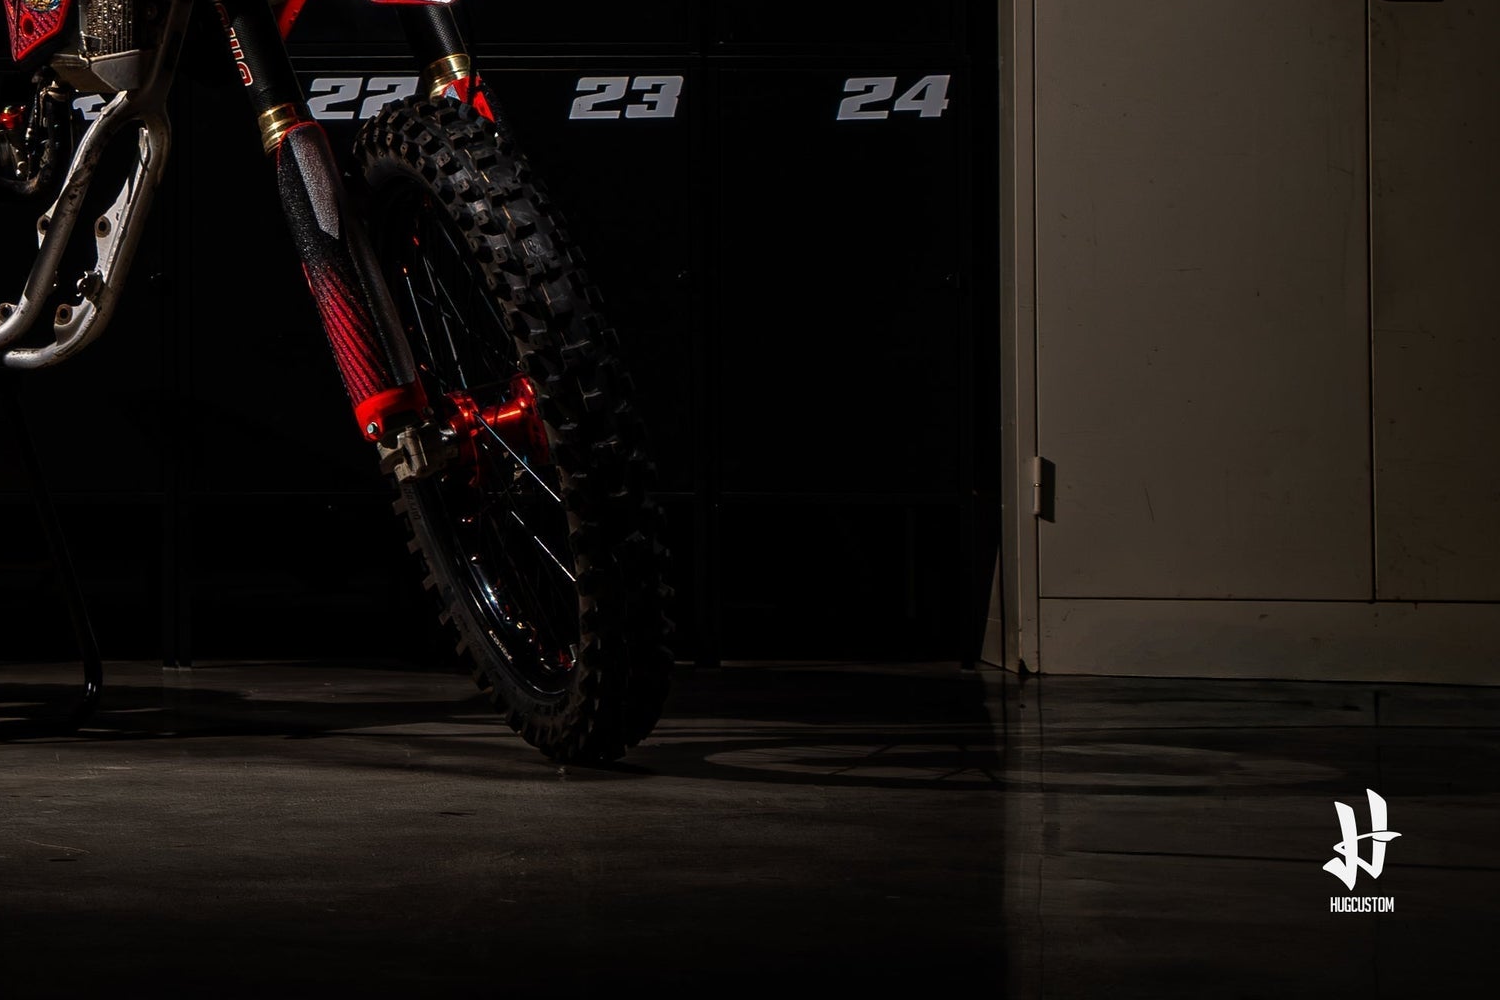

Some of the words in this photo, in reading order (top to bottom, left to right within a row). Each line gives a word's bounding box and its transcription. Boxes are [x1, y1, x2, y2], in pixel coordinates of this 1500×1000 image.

[307, 77, 420, 120] 22
[569, 76, 684, 120] 23
[837, 75, 950, 120] 24
